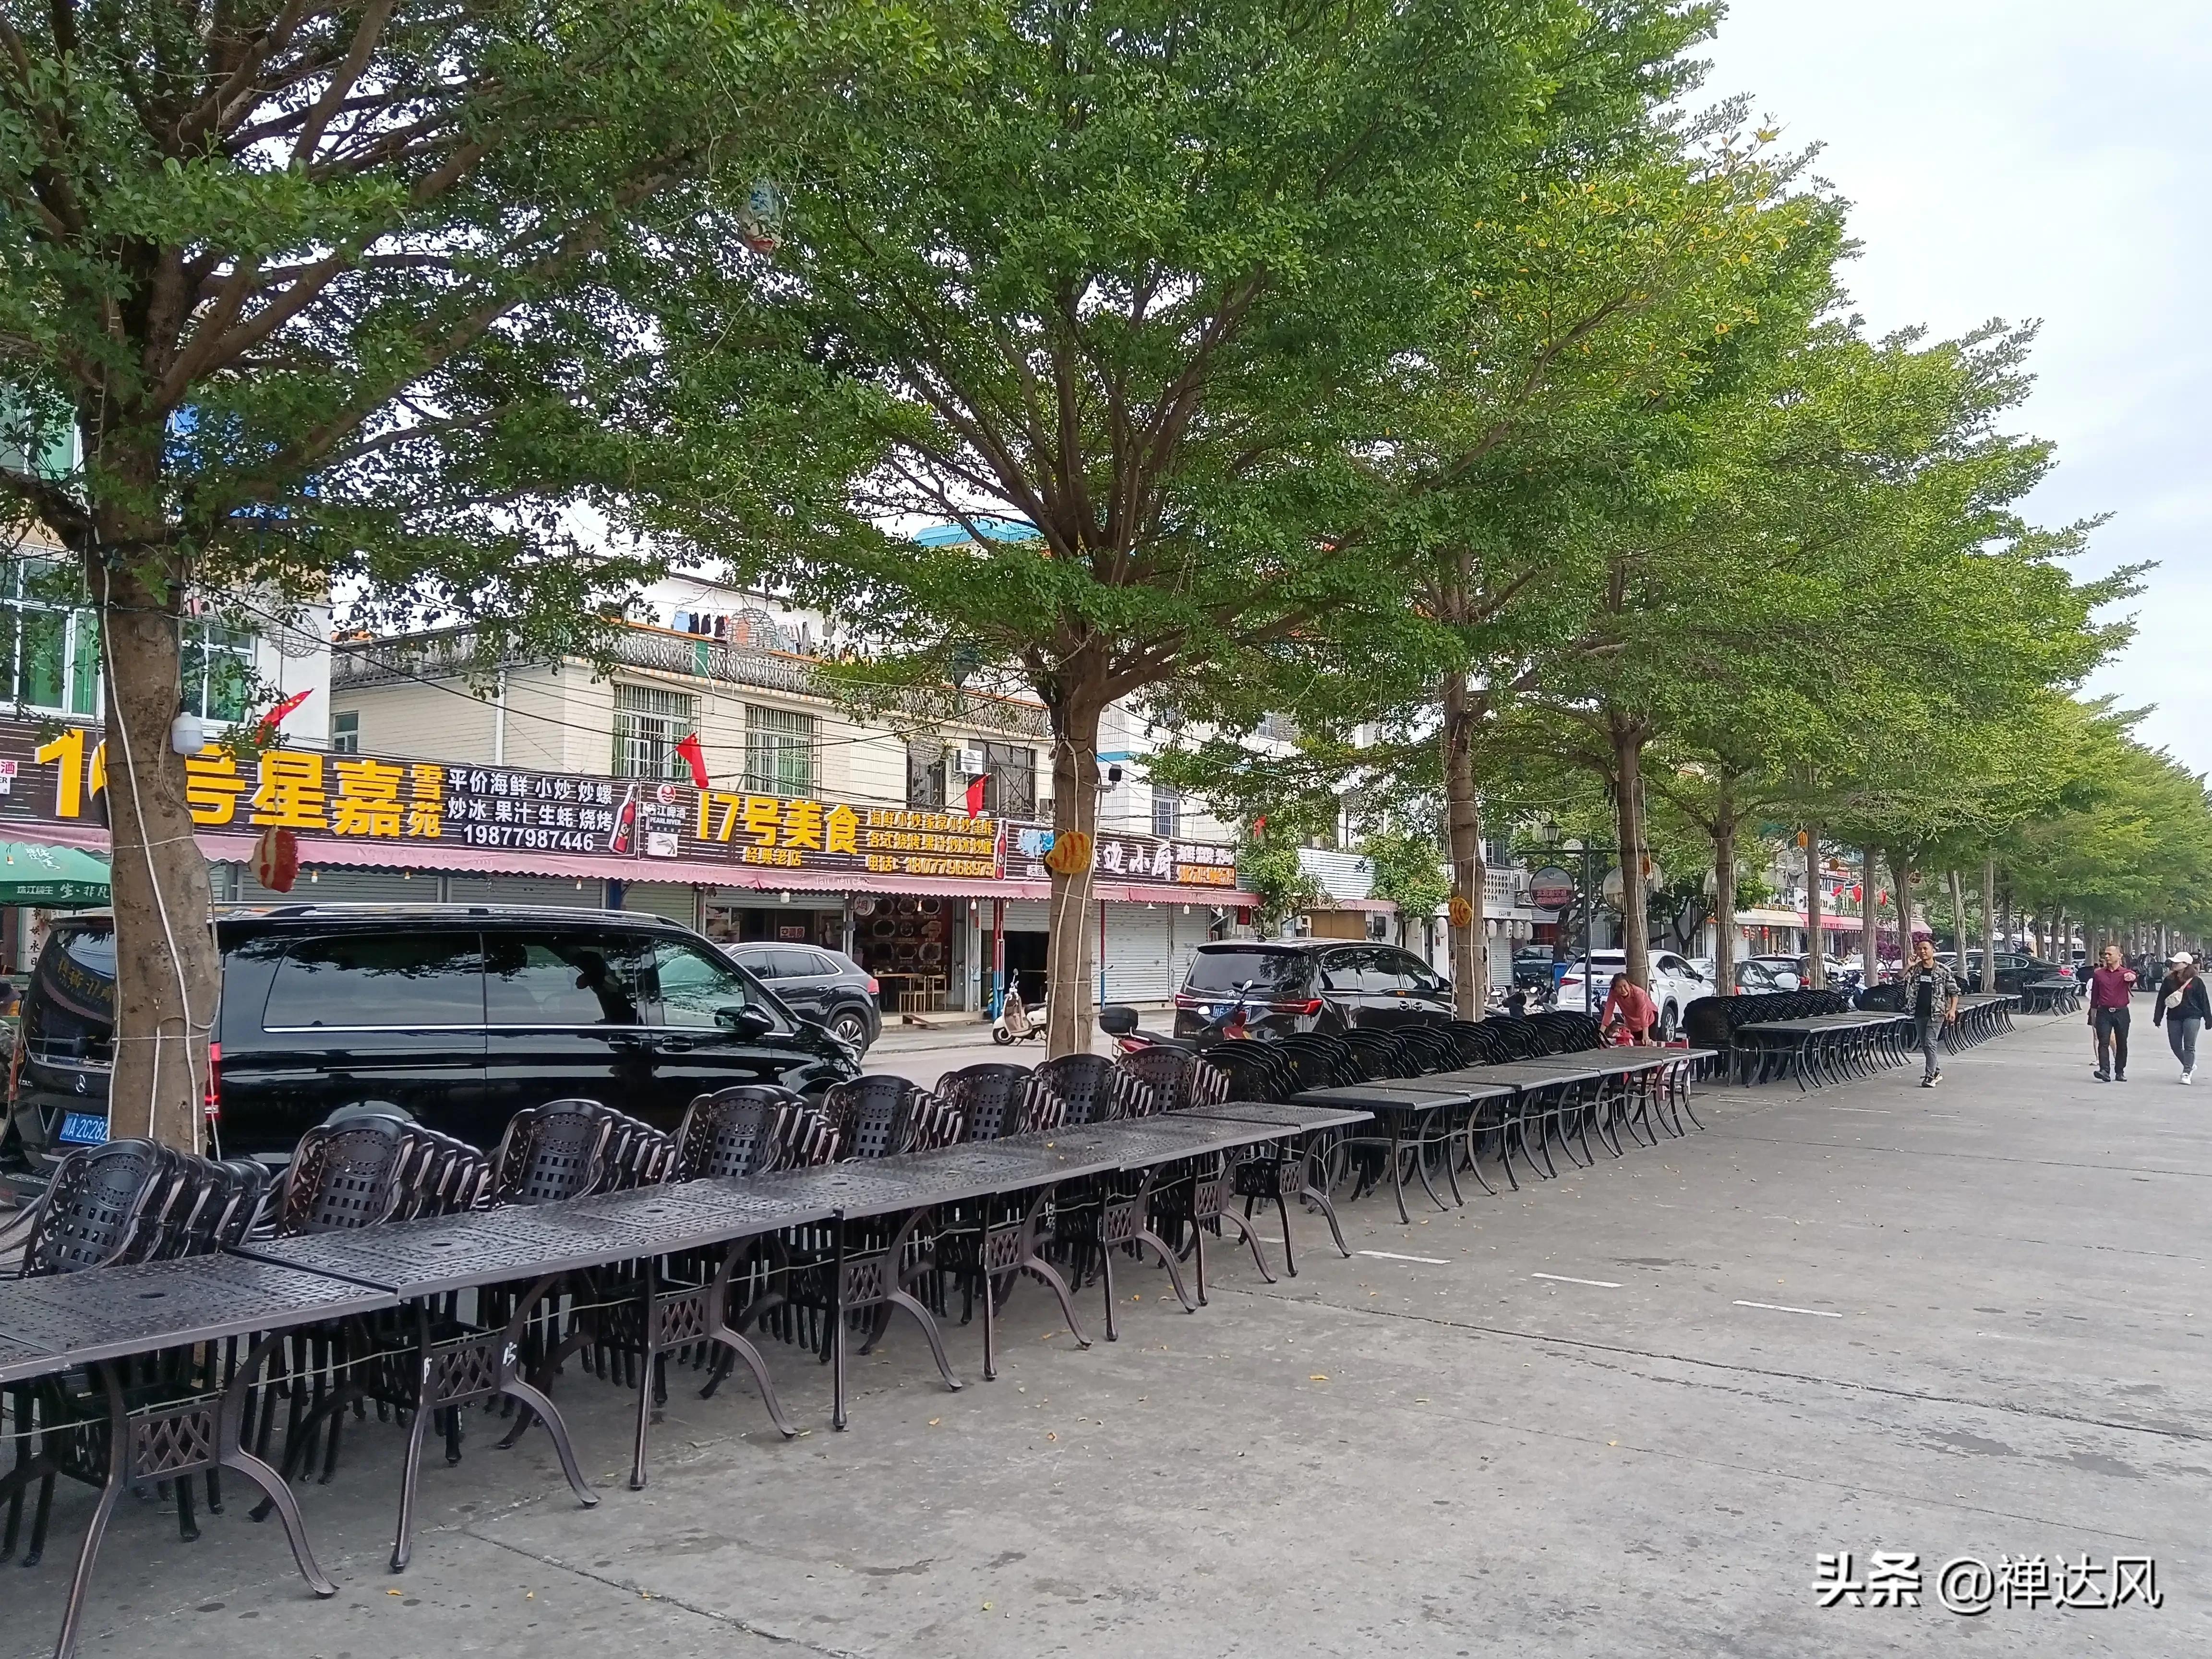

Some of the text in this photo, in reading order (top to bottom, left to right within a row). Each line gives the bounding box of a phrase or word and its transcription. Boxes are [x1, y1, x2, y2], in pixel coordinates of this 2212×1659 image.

[35, 729, 404, 837] 1号星嘉
[408, 764, 443, 838] 雪苑
[448, 768, 613, 805] 平价海鲜 小炒 炒螺
[448, 796, 614, 832] 炒冰 果汁 生蚝 烧烤
[697, 791, 860, 854] 17号美食
[464, 824, 594, 852] 19877987446
[742, 846, 803, 866] 经典老店
[904, 856, 995, 877] 18077968975
